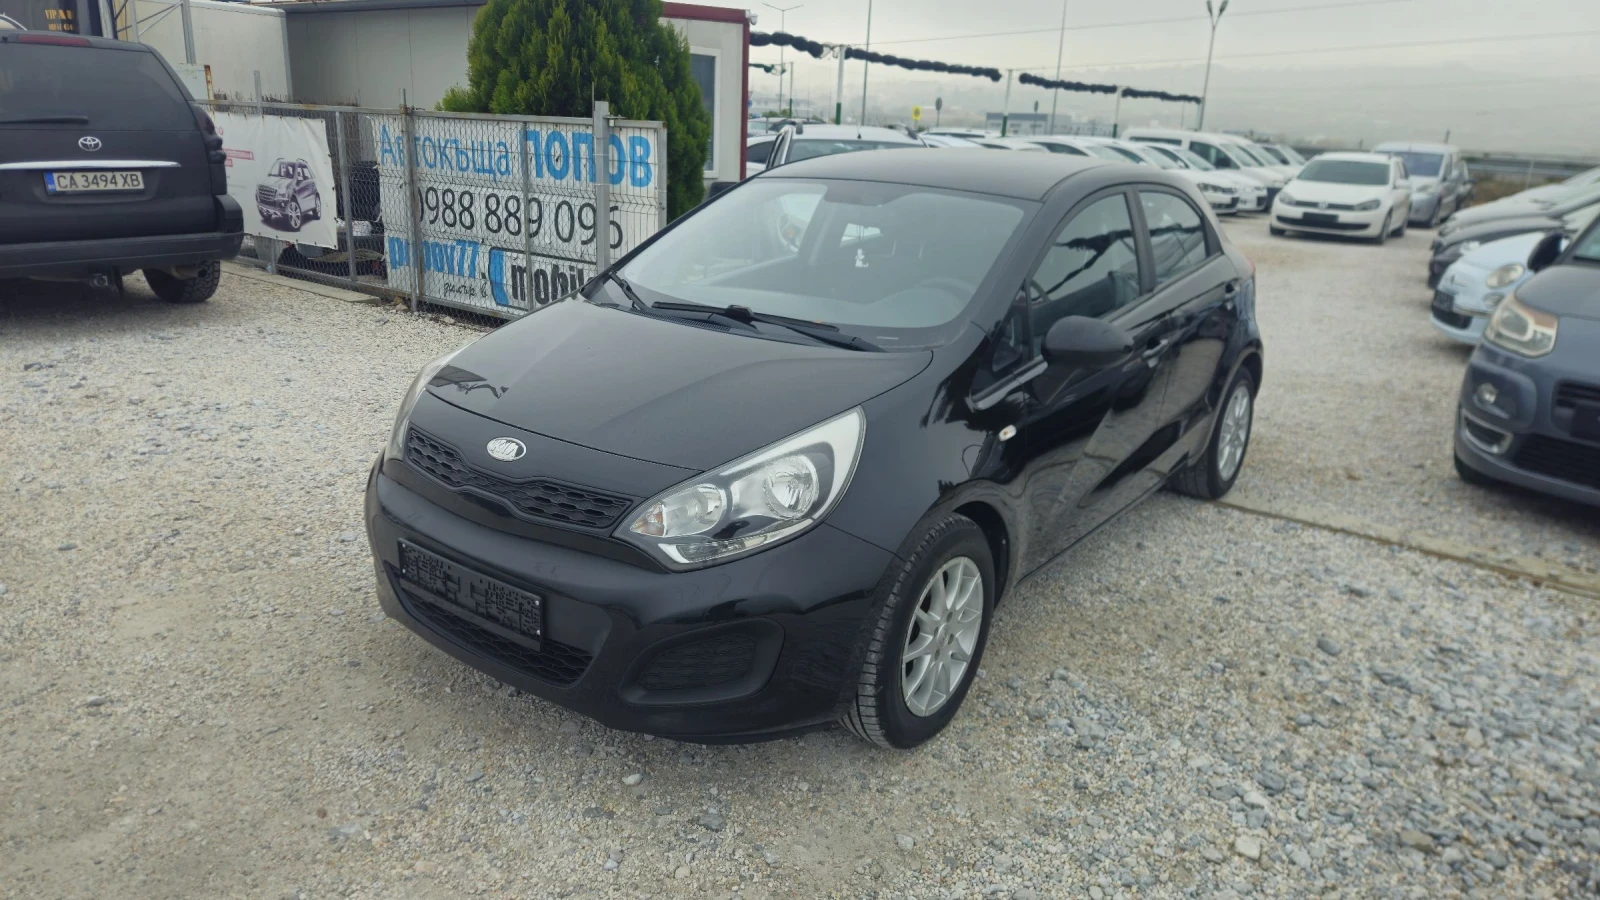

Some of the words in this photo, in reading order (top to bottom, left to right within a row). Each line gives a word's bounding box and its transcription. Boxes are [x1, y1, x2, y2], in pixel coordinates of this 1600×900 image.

[518, 130, 653, 188] ПОПОВ
[57, 174, 78, 189] CA
[81, 174, 118, 189] 3494
[120, 173, 140, 188] XB
[485, 193, 543, 239] 889
[511, 264, 594, 305] mobi
